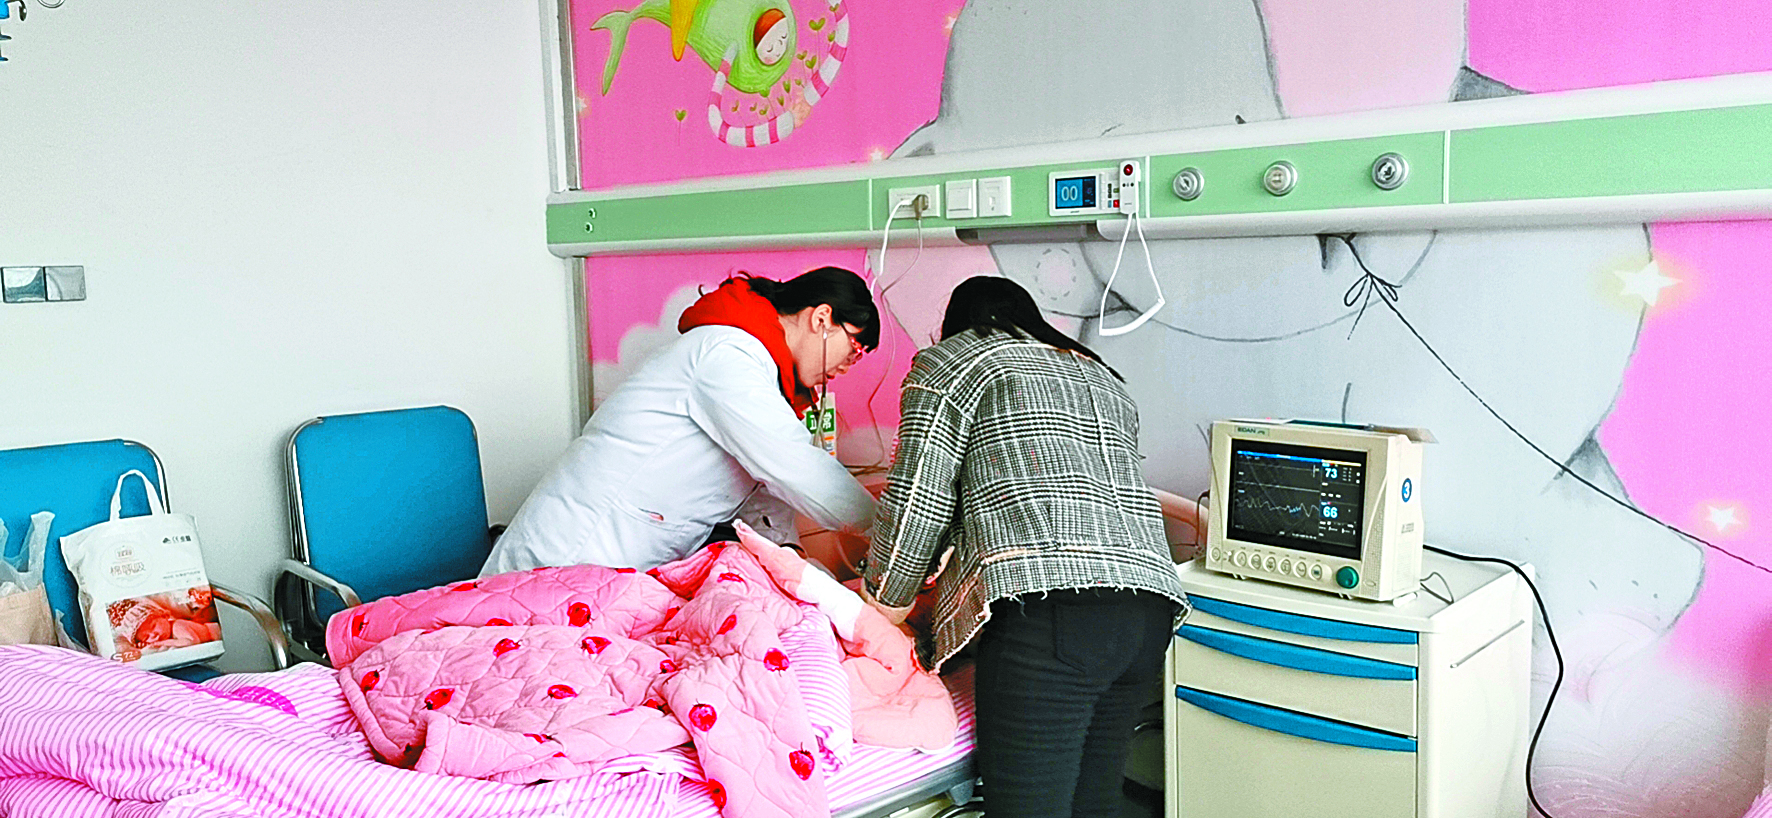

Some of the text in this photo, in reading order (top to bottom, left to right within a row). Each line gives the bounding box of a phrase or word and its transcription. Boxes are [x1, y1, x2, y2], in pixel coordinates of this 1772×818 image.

[1061, 185, 1078, 202] 00
[1324, 467, 1338, 479] 73
[1322, 506, 1338, 519] 66
